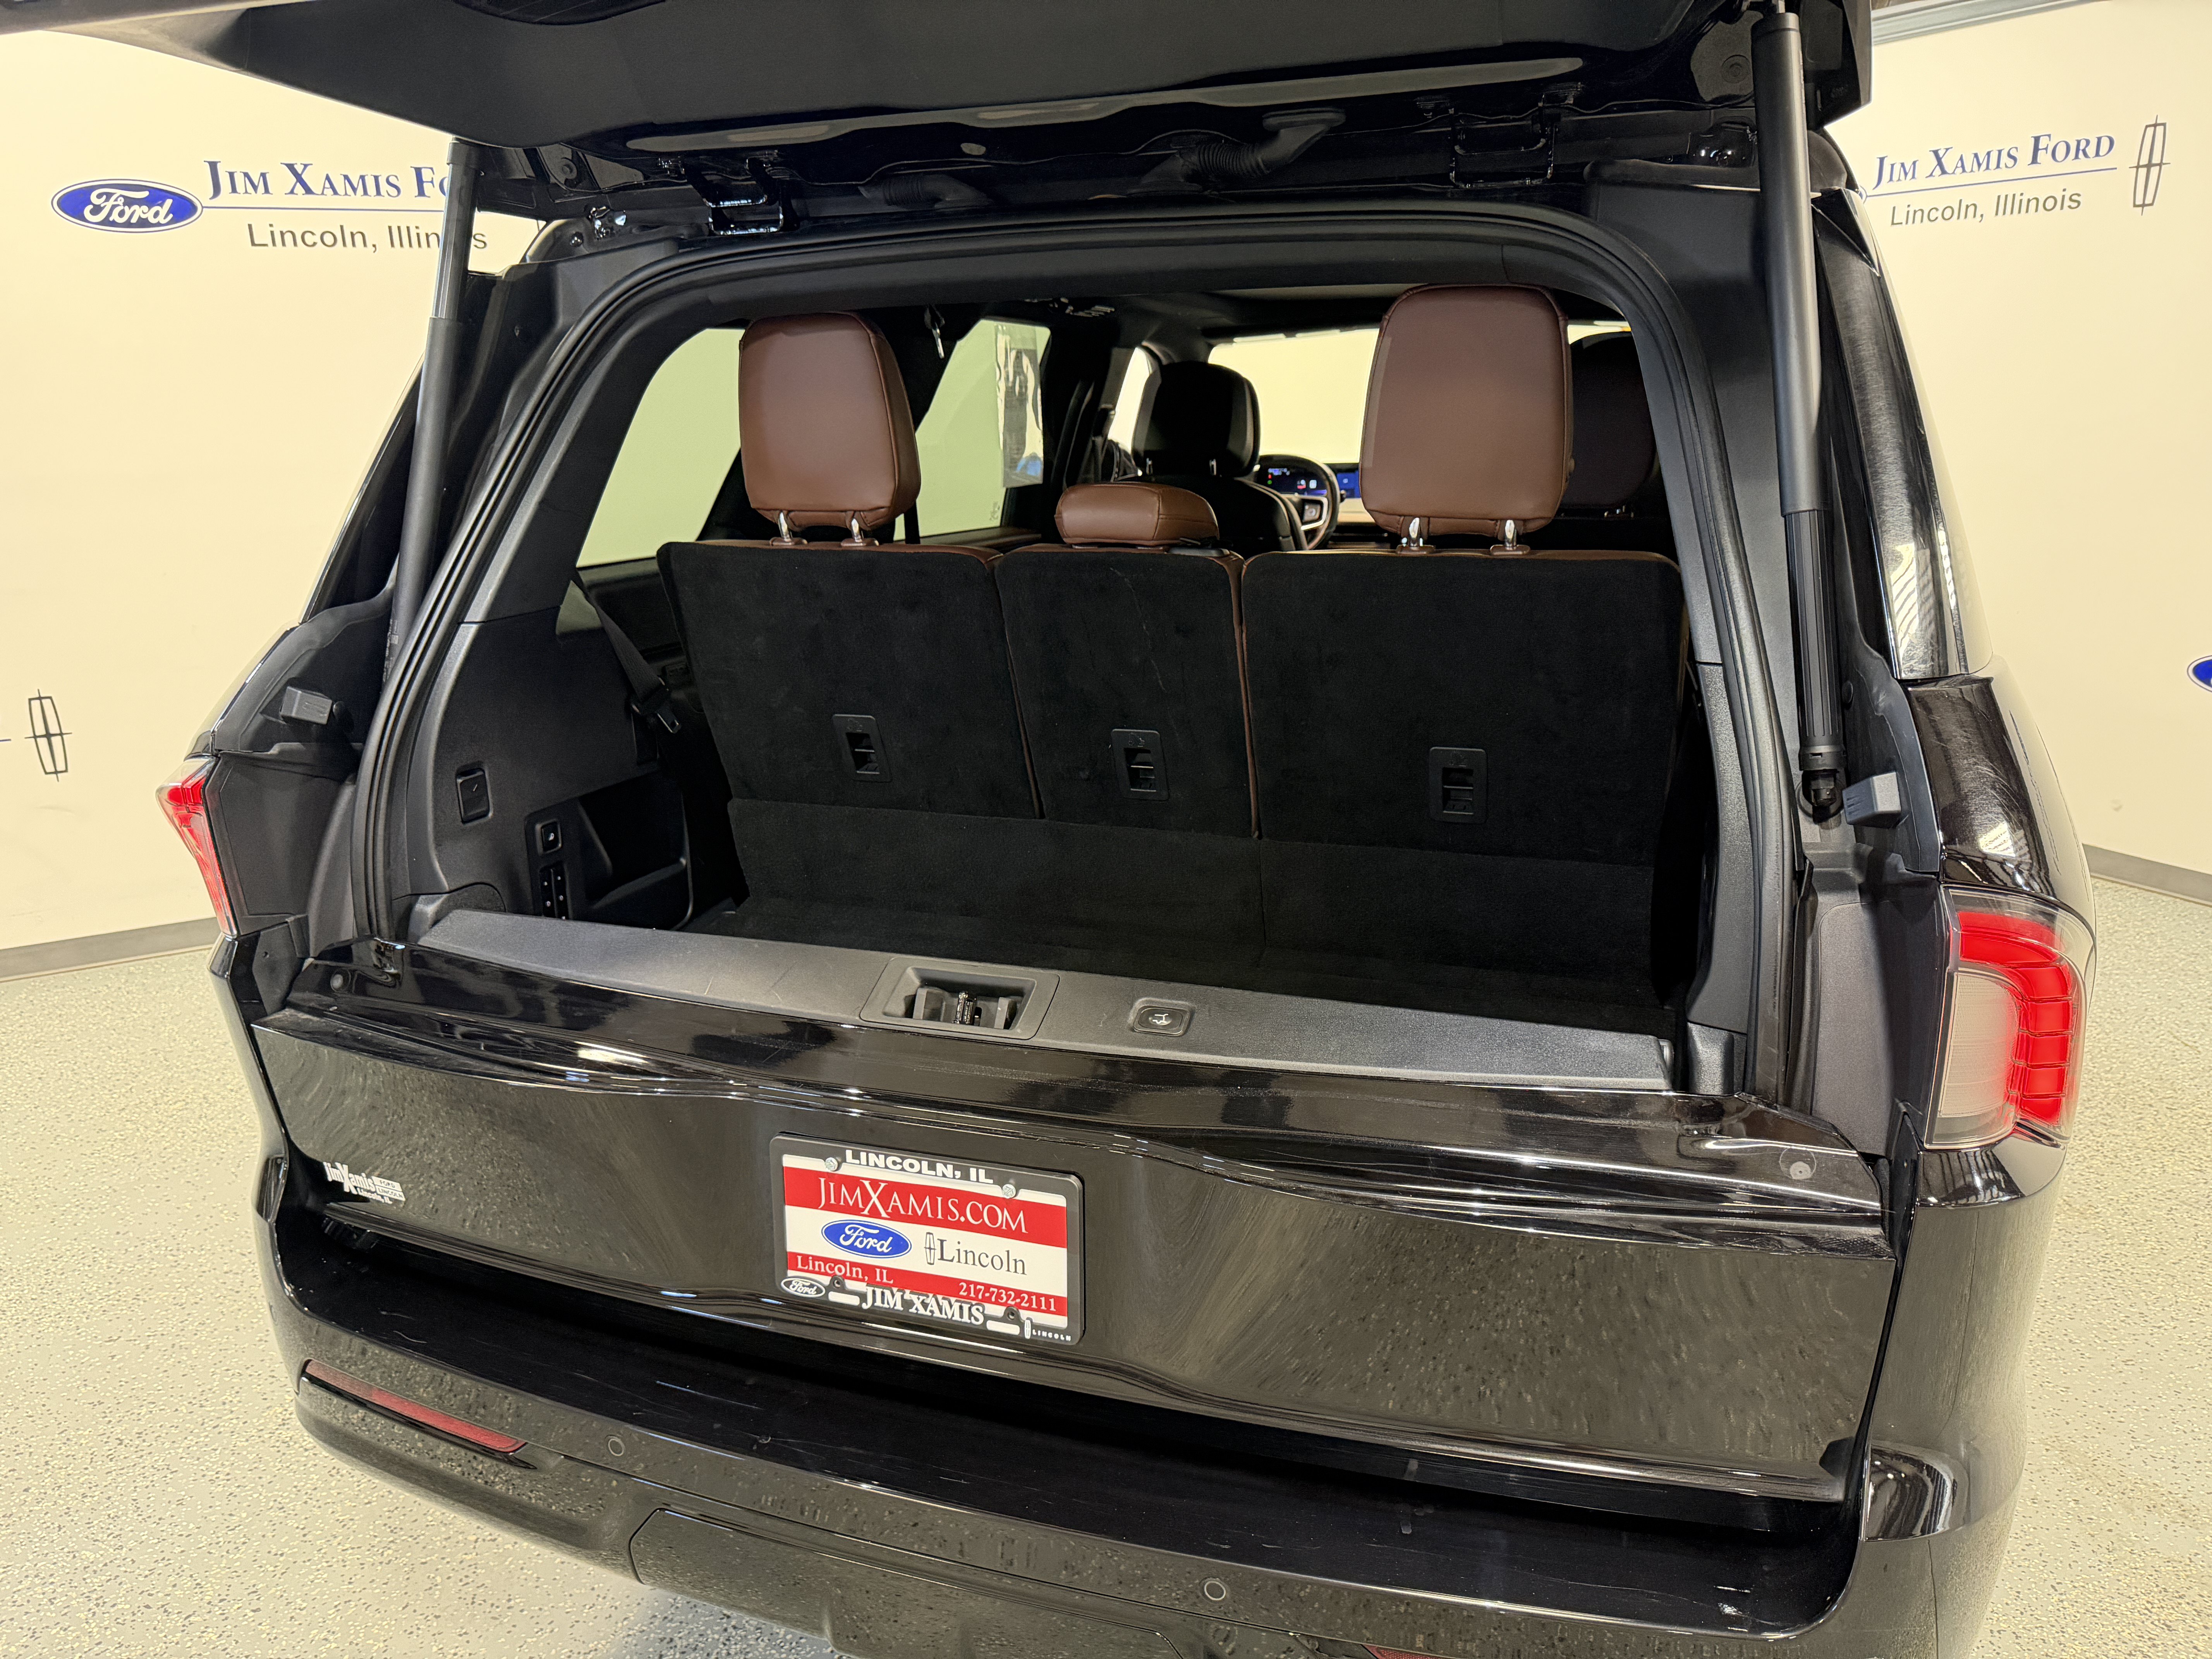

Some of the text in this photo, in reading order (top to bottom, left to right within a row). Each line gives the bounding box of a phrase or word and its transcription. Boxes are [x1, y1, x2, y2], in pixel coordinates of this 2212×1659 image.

[1872, 134, 2115, 190] JIM XAMIS FORD
[204, 161, 273, 199] JIM
[281, 163, 401, 198] XAMIS
[84, 188, 173, 223] Ford
[1891, 189, 2081, 226] Lincoln, Illinois
[248, 224, 487, 253] Lincoln, Illins
[846, 1150, 993, 1183] LINCOLN, IL
[378, 1188, 403, 1198] LINCOLN
[818, 1178, 1028, 1233] JIMXAMIS.COM
[840, 1224, 893, 1253] Ford
[797, 1256, 893, 1283] Lincoln, IL
[938, 1239, 1027, 1275] Lincoln
[789, 1280, 816, 1295] Ford
[959, 1283, 1056, 1311] 217-732-2111
[862, 1286, 984, 1324] JIM XAMIS
[1032, 1329, 1071, 1341] LINCOLN
